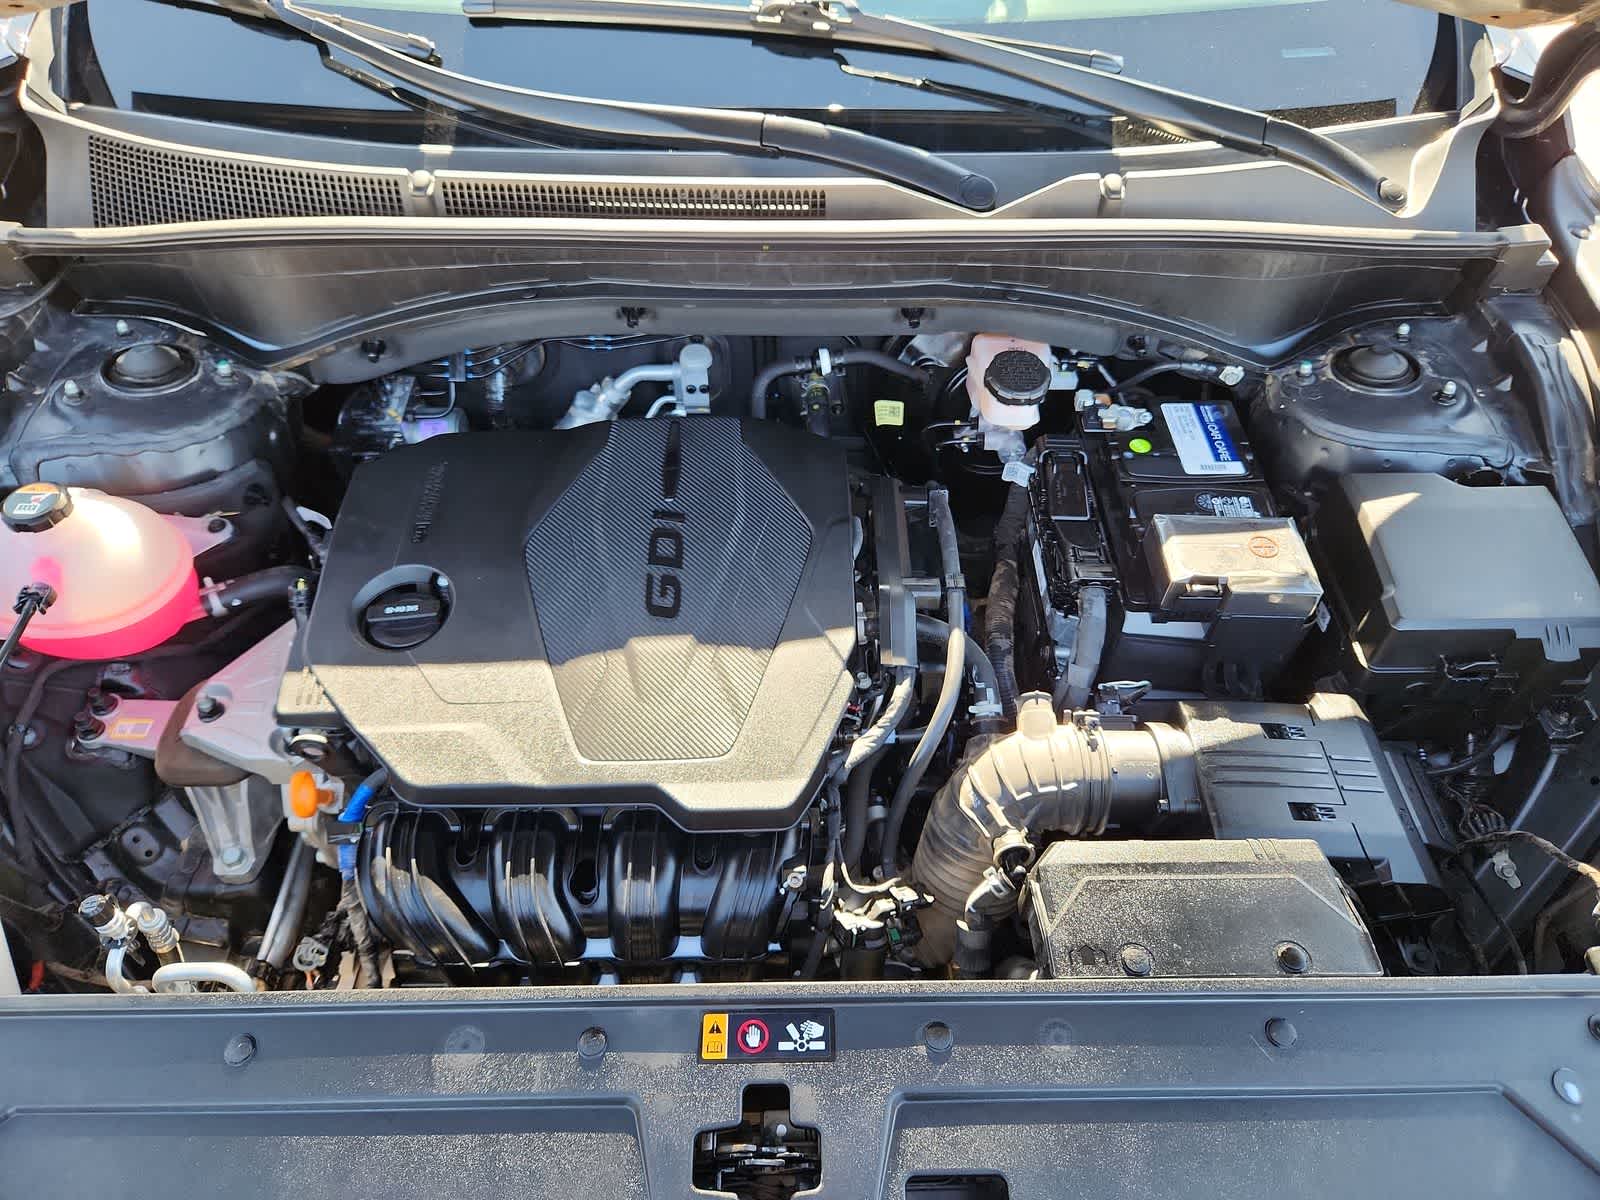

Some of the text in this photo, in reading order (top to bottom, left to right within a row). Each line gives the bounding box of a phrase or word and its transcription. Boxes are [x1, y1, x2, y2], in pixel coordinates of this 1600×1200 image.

[1207, 424, 1231, 462] CAR CARE
[646, 510, 685, 618] GDI
